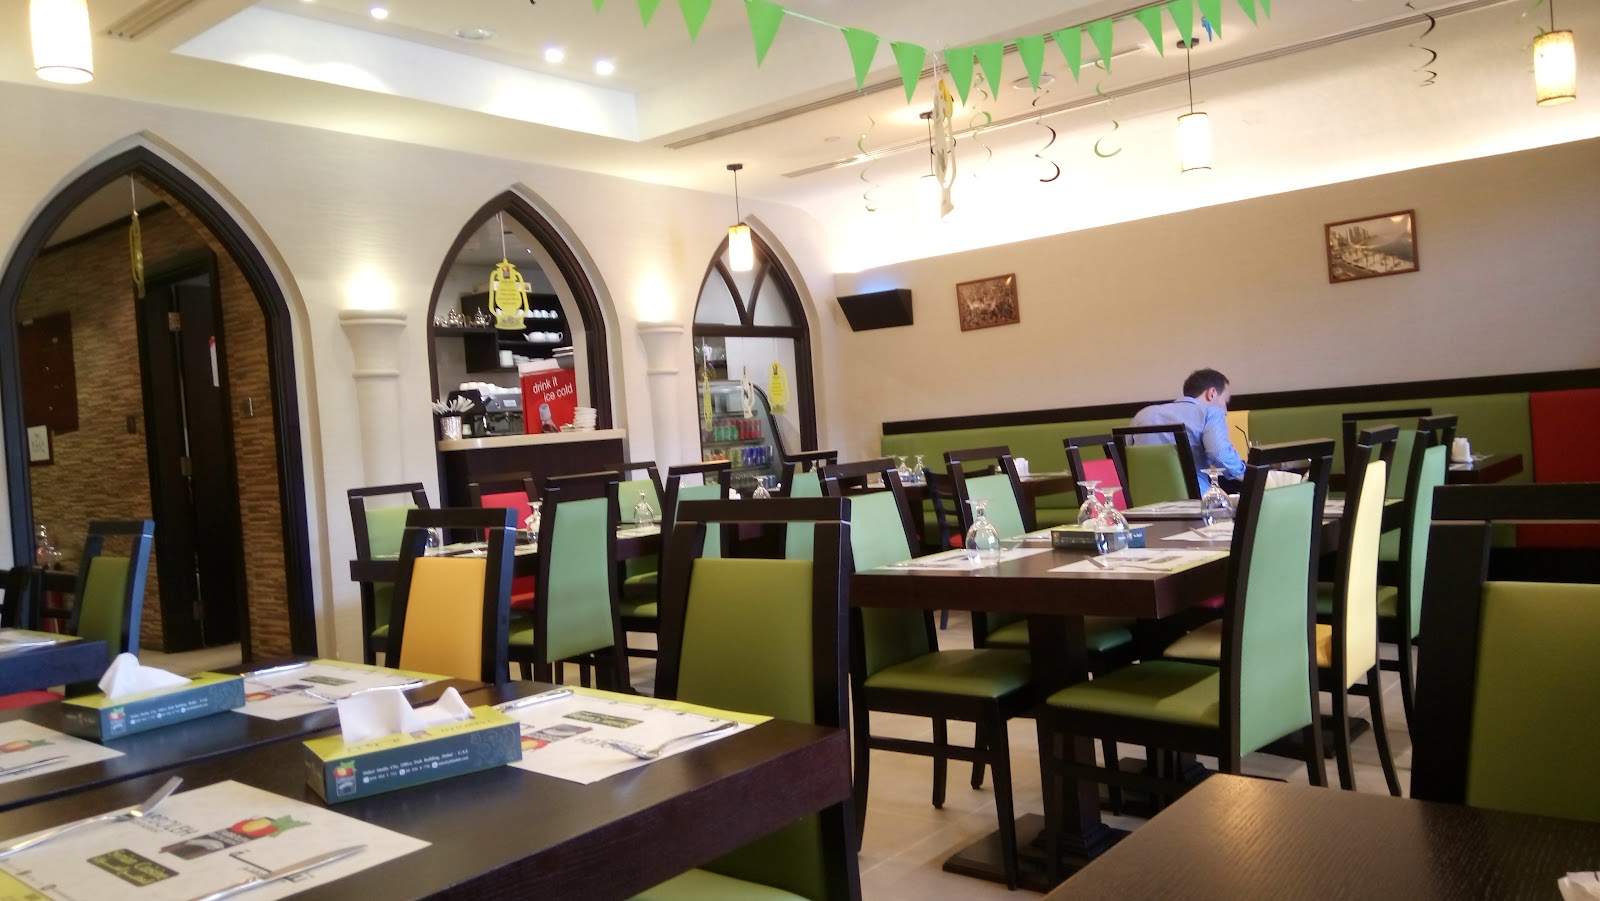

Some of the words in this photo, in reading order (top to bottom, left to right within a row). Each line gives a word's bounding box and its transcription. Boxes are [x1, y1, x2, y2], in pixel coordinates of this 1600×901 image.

[533, 379, 551, 394] drink
[552, 376, 558, 387] it
[543, 392, 555, 402] ice
[556, 383, 573, 398] cold
